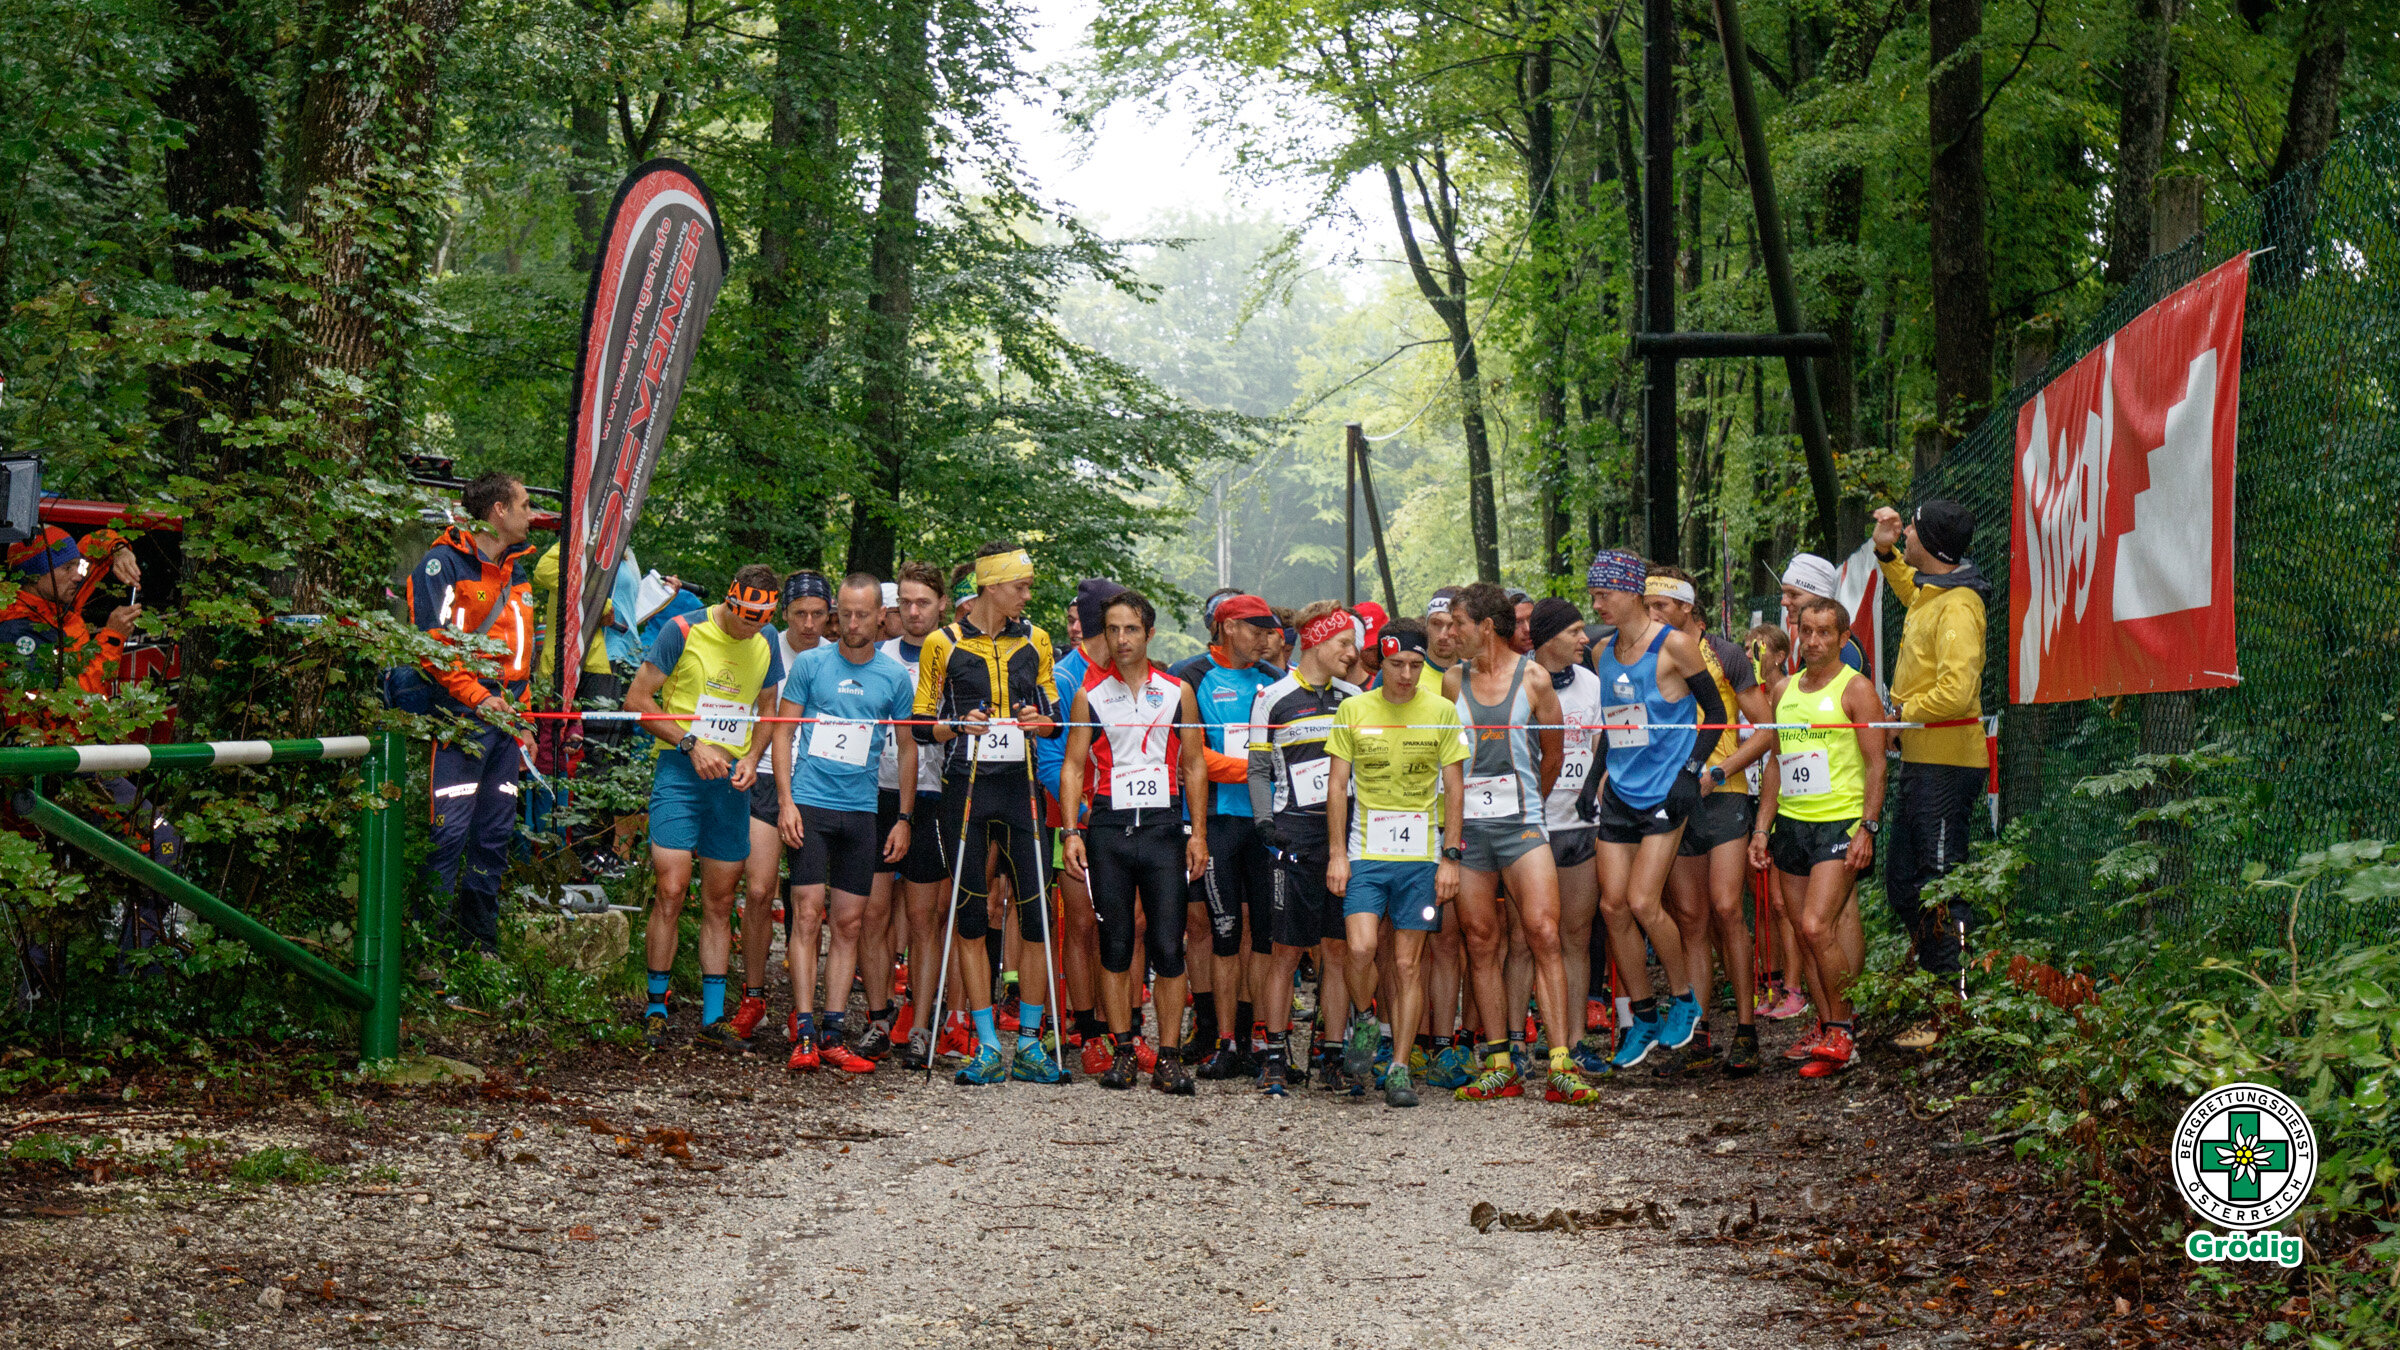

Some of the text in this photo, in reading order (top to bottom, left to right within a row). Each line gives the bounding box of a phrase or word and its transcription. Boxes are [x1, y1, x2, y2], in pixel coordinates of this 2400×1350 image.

[601, 216, 672, 441] www.seyringer.info
[595, 218, 705, 571] SEYRINGER
[838, 687, 864, 696] skinfit
[835, 734, 848, 750] 2
[987, 733, 1009, 749] 34
[1560, 763, 1583, 778] 20
[1792, 767, 1811, 783] 49
[1126, 780, 1157, 796] 128
[1483, 791, 1493, 806] 3
[1390, 826, 1411, 842] 14
